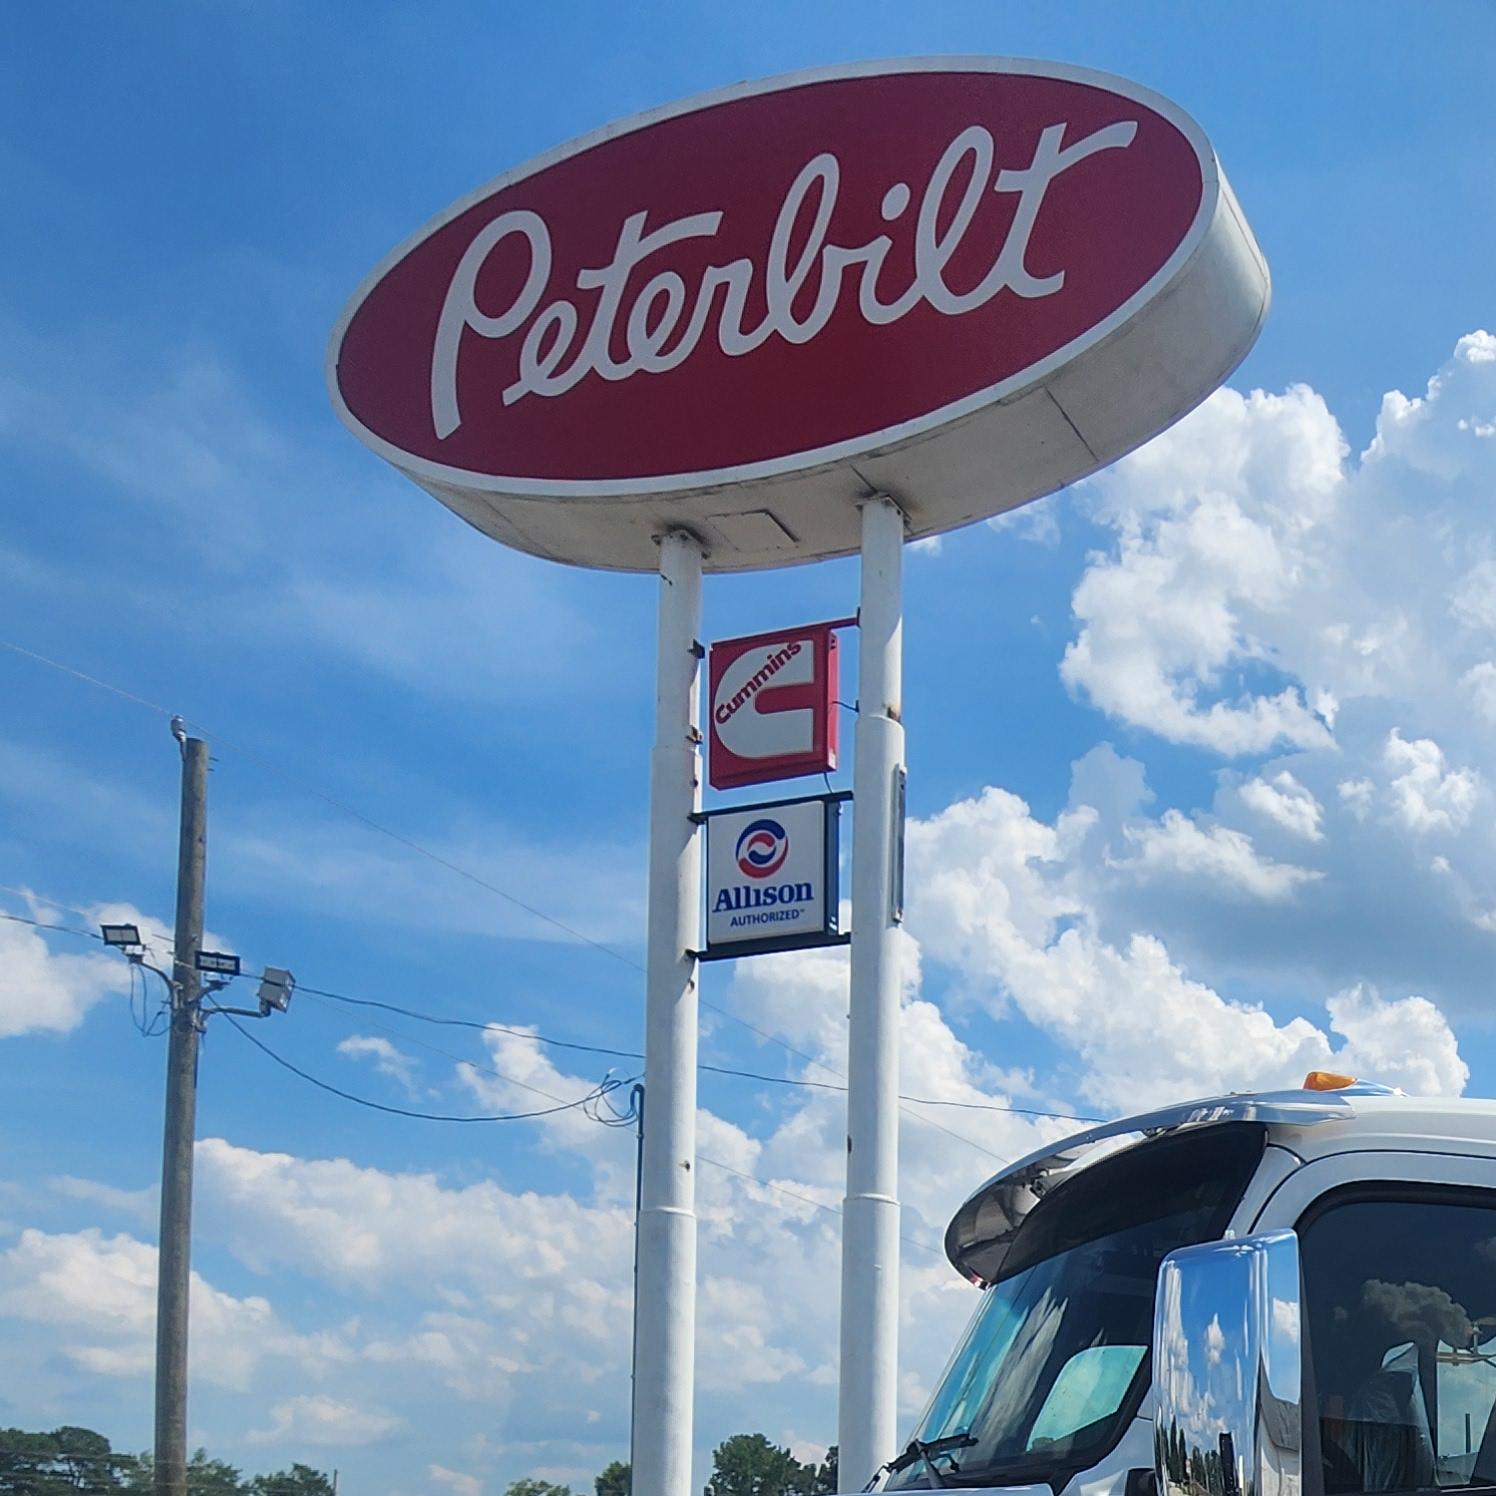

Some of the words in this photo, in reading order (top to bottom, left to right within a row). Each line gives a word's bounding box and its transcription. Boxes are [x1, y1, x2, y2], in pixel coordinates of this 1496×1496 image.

[430, 120, 1138, 440] Peterbilt
[715, 642, 802, 724] Cummins
[712, 882, 814, 913] Allison
